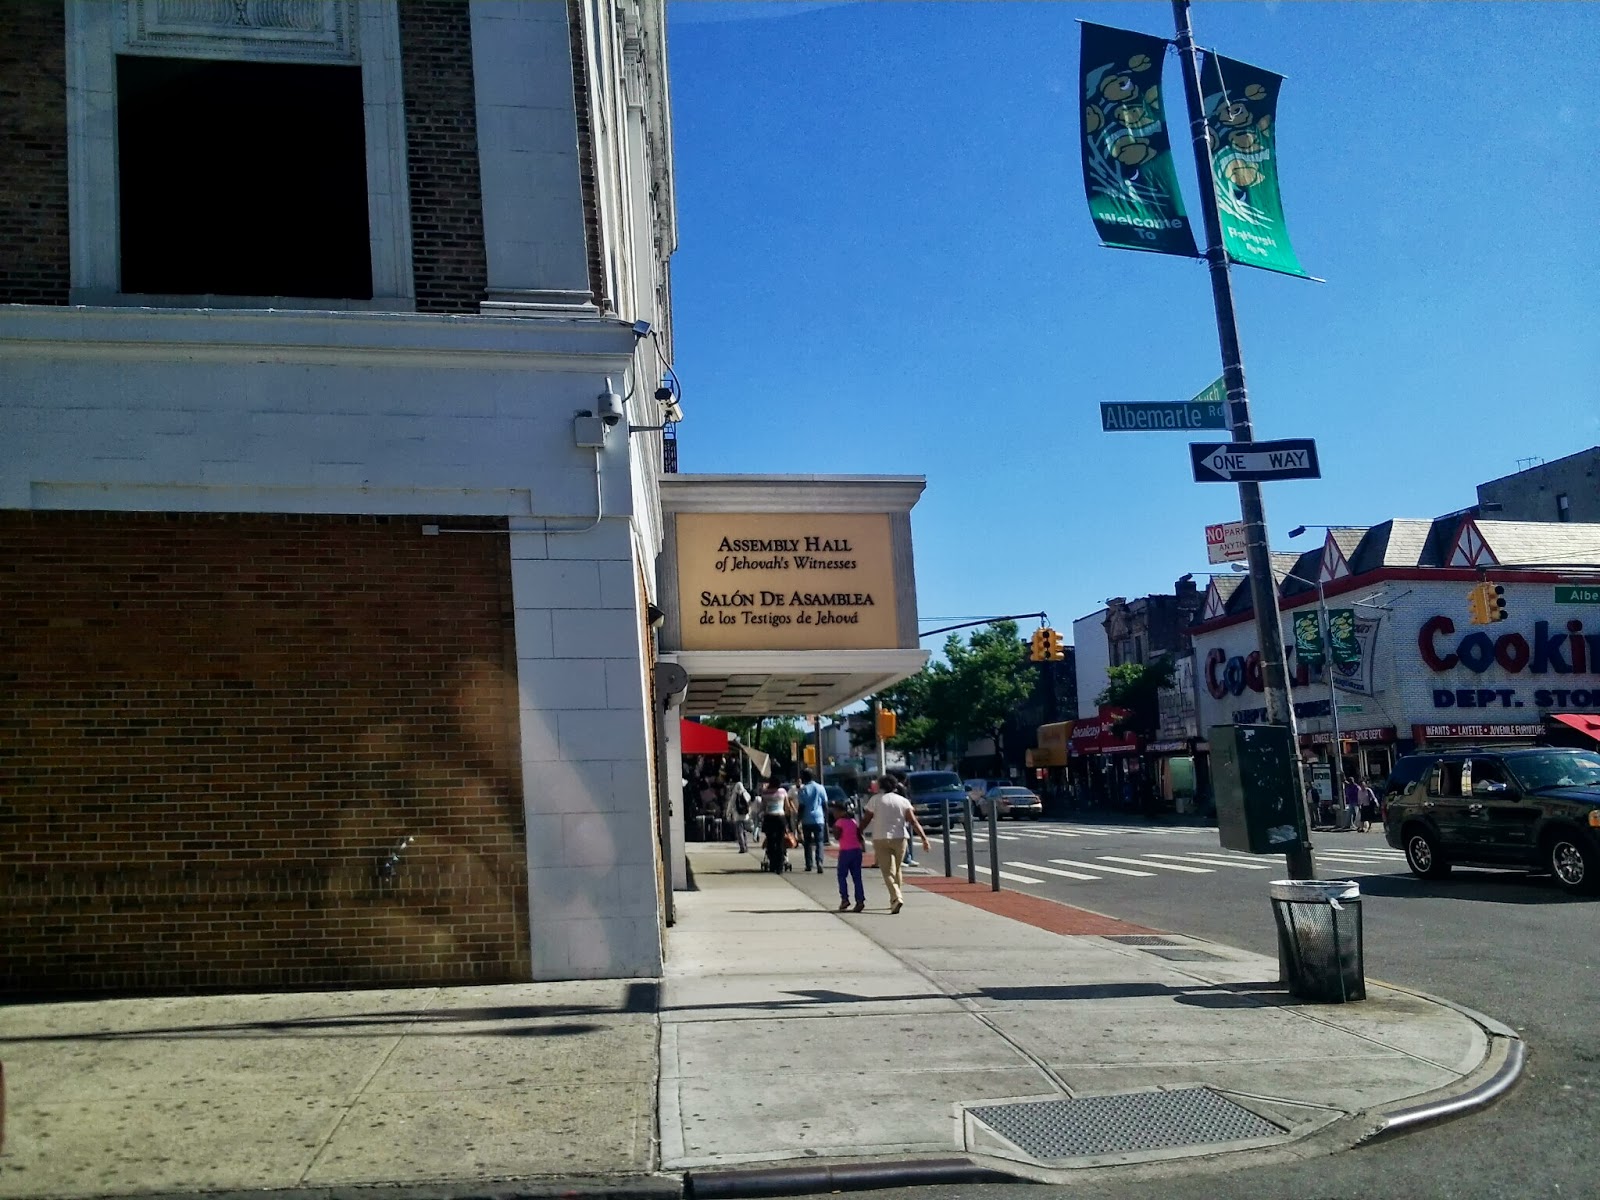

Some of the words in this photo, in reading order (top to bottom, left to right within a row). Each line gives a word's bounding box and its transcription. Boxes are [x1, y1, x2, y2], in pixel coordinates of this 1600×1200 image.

[1098, 212, 1183, 230] Welcome
[1137, 228, 1157, 240] To
[1106, 405, 1202, 429] Albemarle
[1209, 405, 1224, 417] Rd
[1213, 455, 1246, 470] ONE
[1269, 451, 1305, 468] WAY
[1206, 527, 1223, 543] NO
[717, 536, 799, 552] ASSEMBLY
[804, 536, 852, 552] HALL
[715, 556, 729, 572] of
[731, 556, 789, 571] Jehovah's
[793, 556, 857, 570] Witnesses
[700, 589, 754, 607] SALÓN
[789, 590, 875, 606] ASAMBLEA
[1570, 590, 1600, 601] Albe
[700, 611, 715, 625] de
[719, 611, 736, 625] los
[741, 611, 791, 627] Testigos
[796, 611, 812, 625] de
[815, 611, 859, 626] Jehová
[1432, 689, 1524, 708] DEPT.
[1426, 725, 1450, 736] INFANTS
[1457, 725, 1483, 736] LAYETTE
[1489, 724, 1515, 735] JUVENILE
[1515, 724, 1546, 735] FURNITURE
